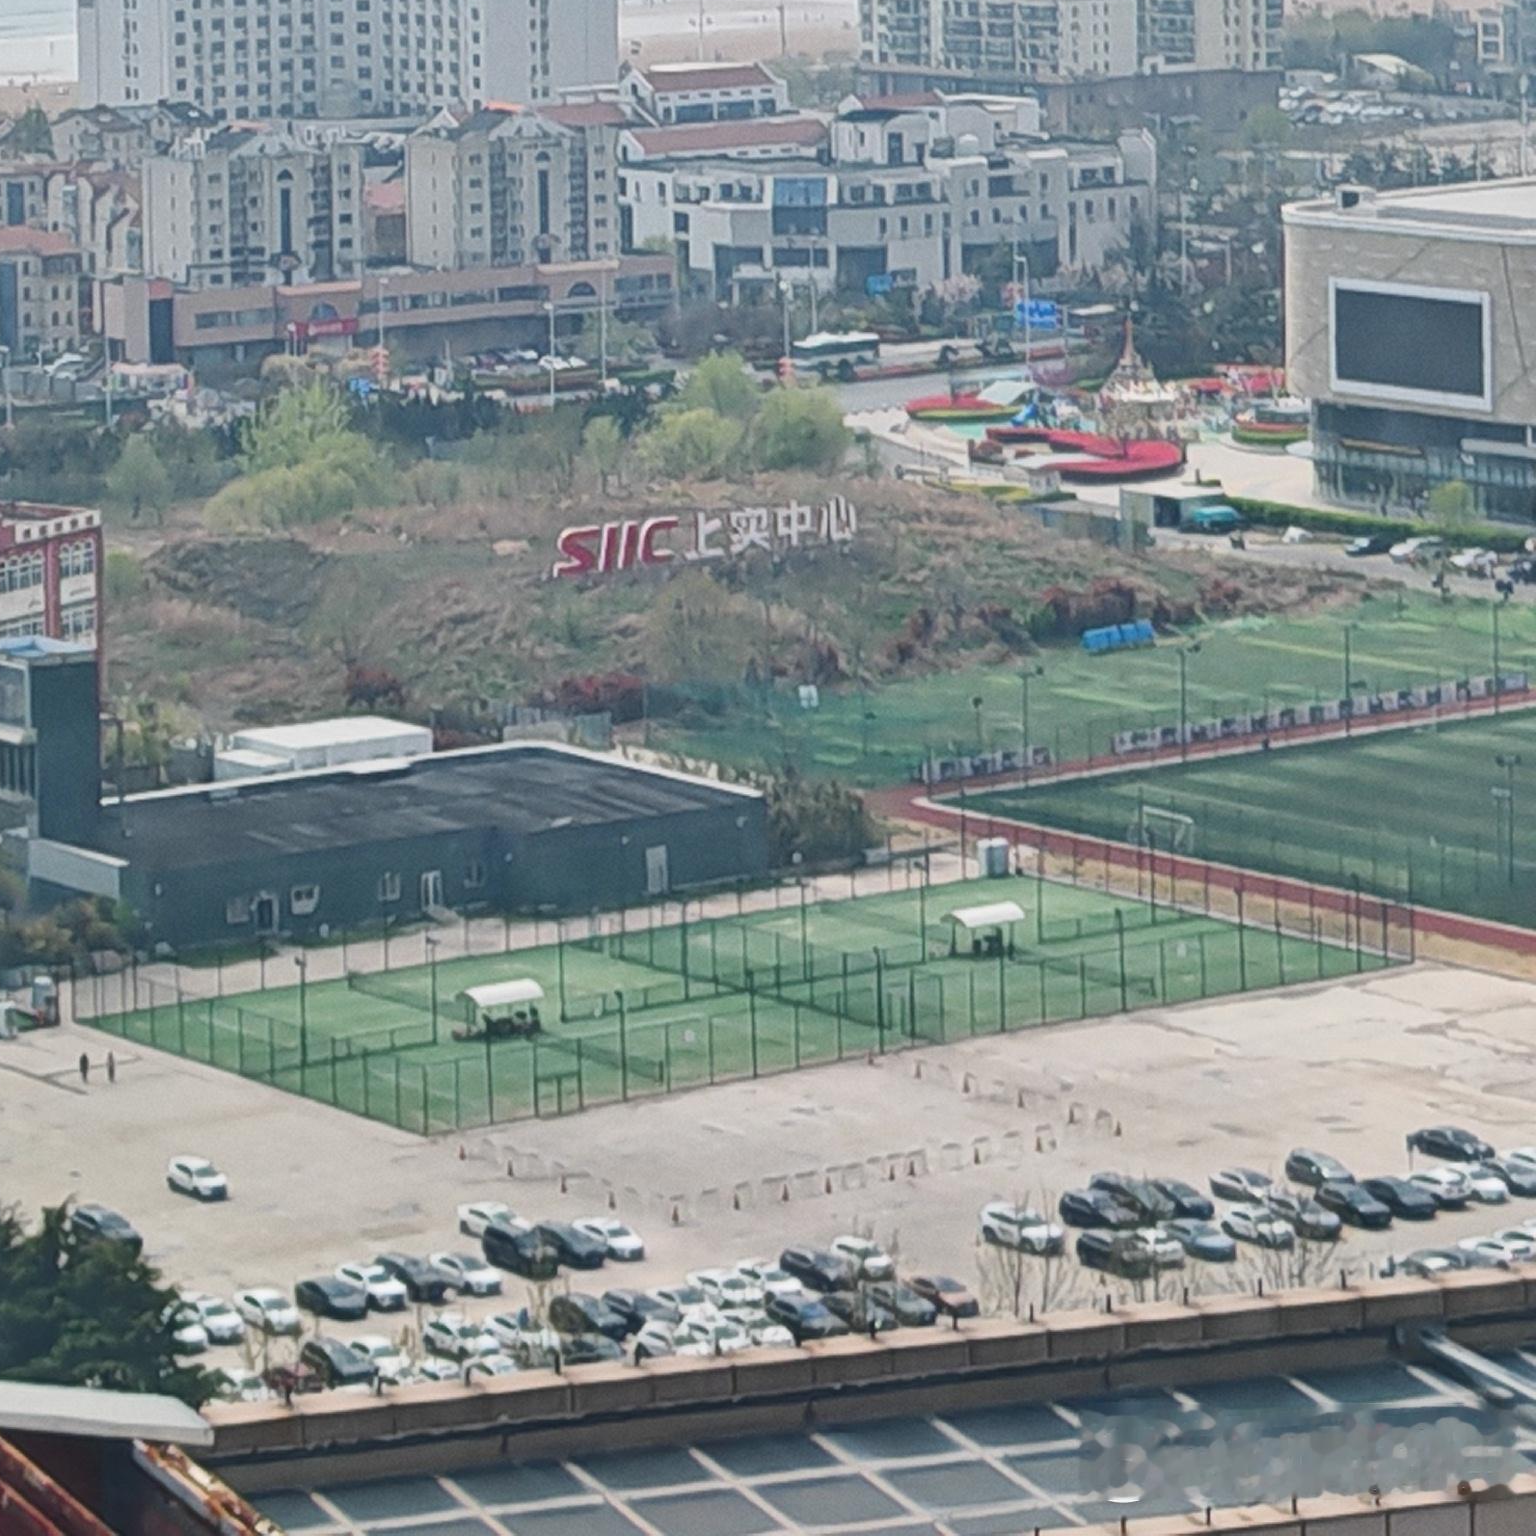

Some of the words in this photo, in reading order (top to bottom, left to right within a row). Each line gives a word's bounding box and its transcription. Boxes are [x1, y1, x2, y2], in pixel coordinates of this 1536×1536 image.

[553, 515, 679, 578] SIIC
[685, 495, 858, 561] 上实中心
